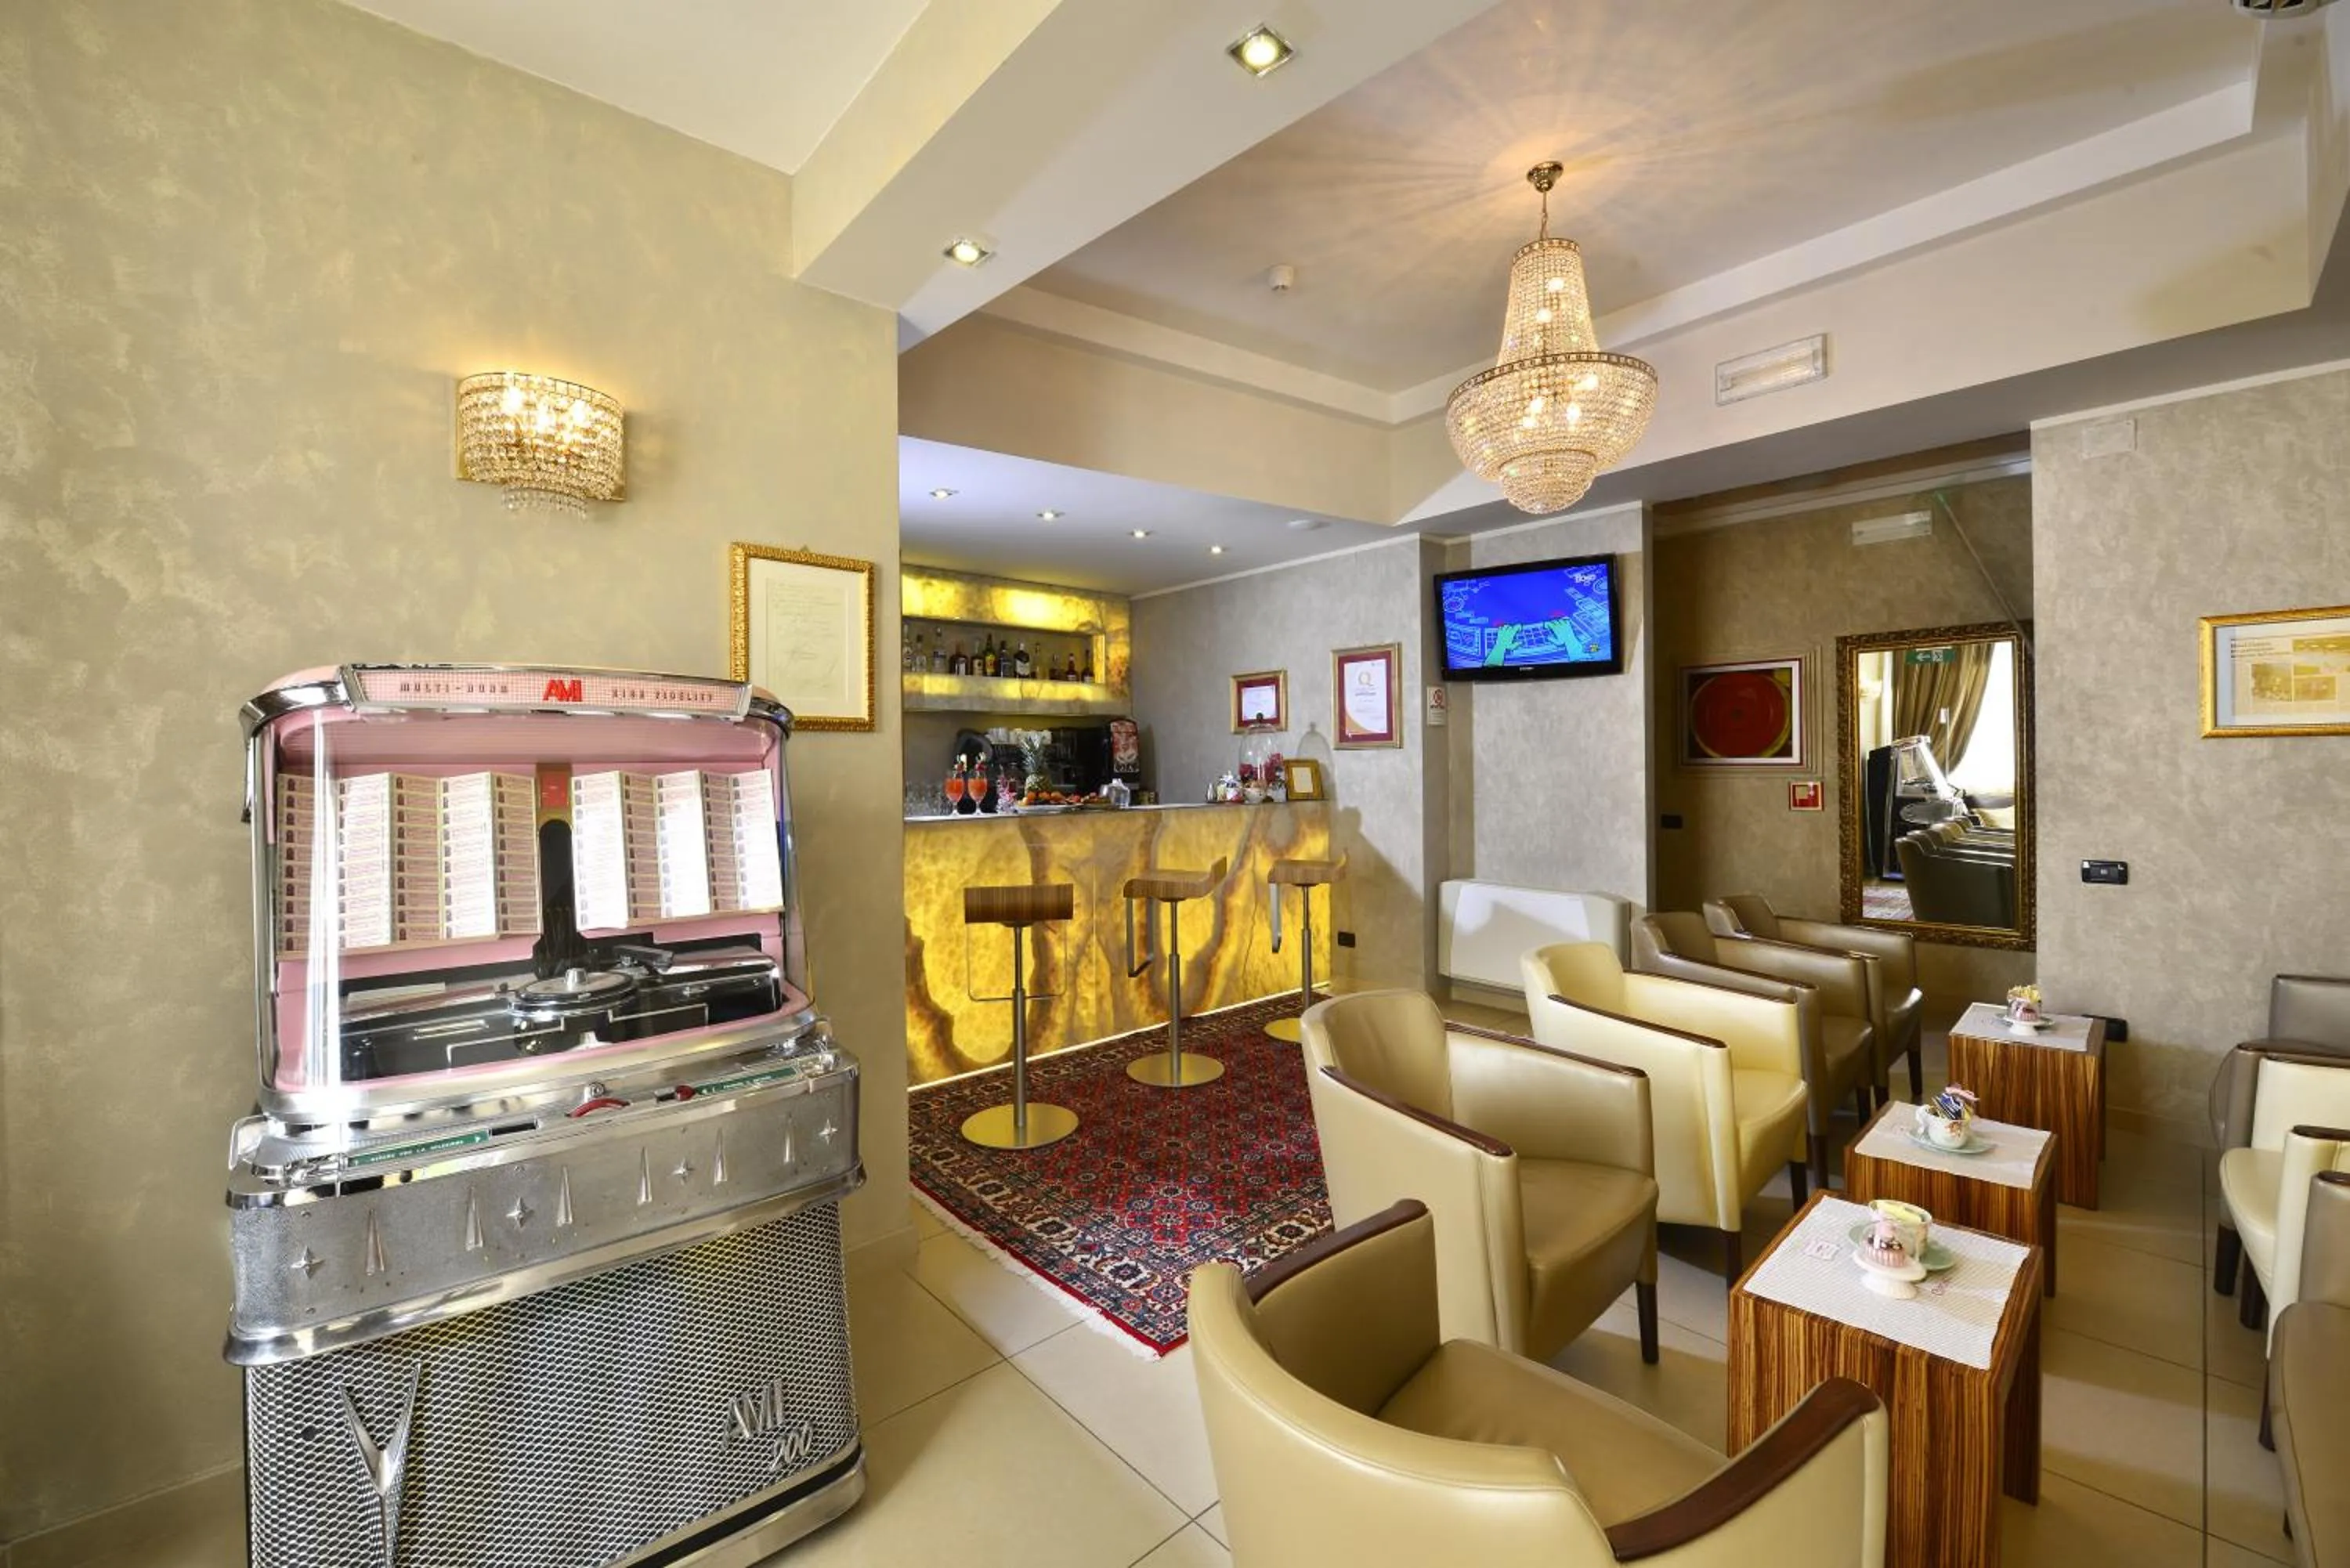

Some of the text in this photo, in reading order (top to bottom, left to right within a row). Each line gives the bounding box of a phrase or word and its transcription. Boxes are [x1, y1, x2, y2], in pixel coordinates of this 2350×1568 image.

[542, 679, 583, 702] AMI
[655, 690, 713, 702] FIDELITY
[721, 1378, 783, 1449] AMI
